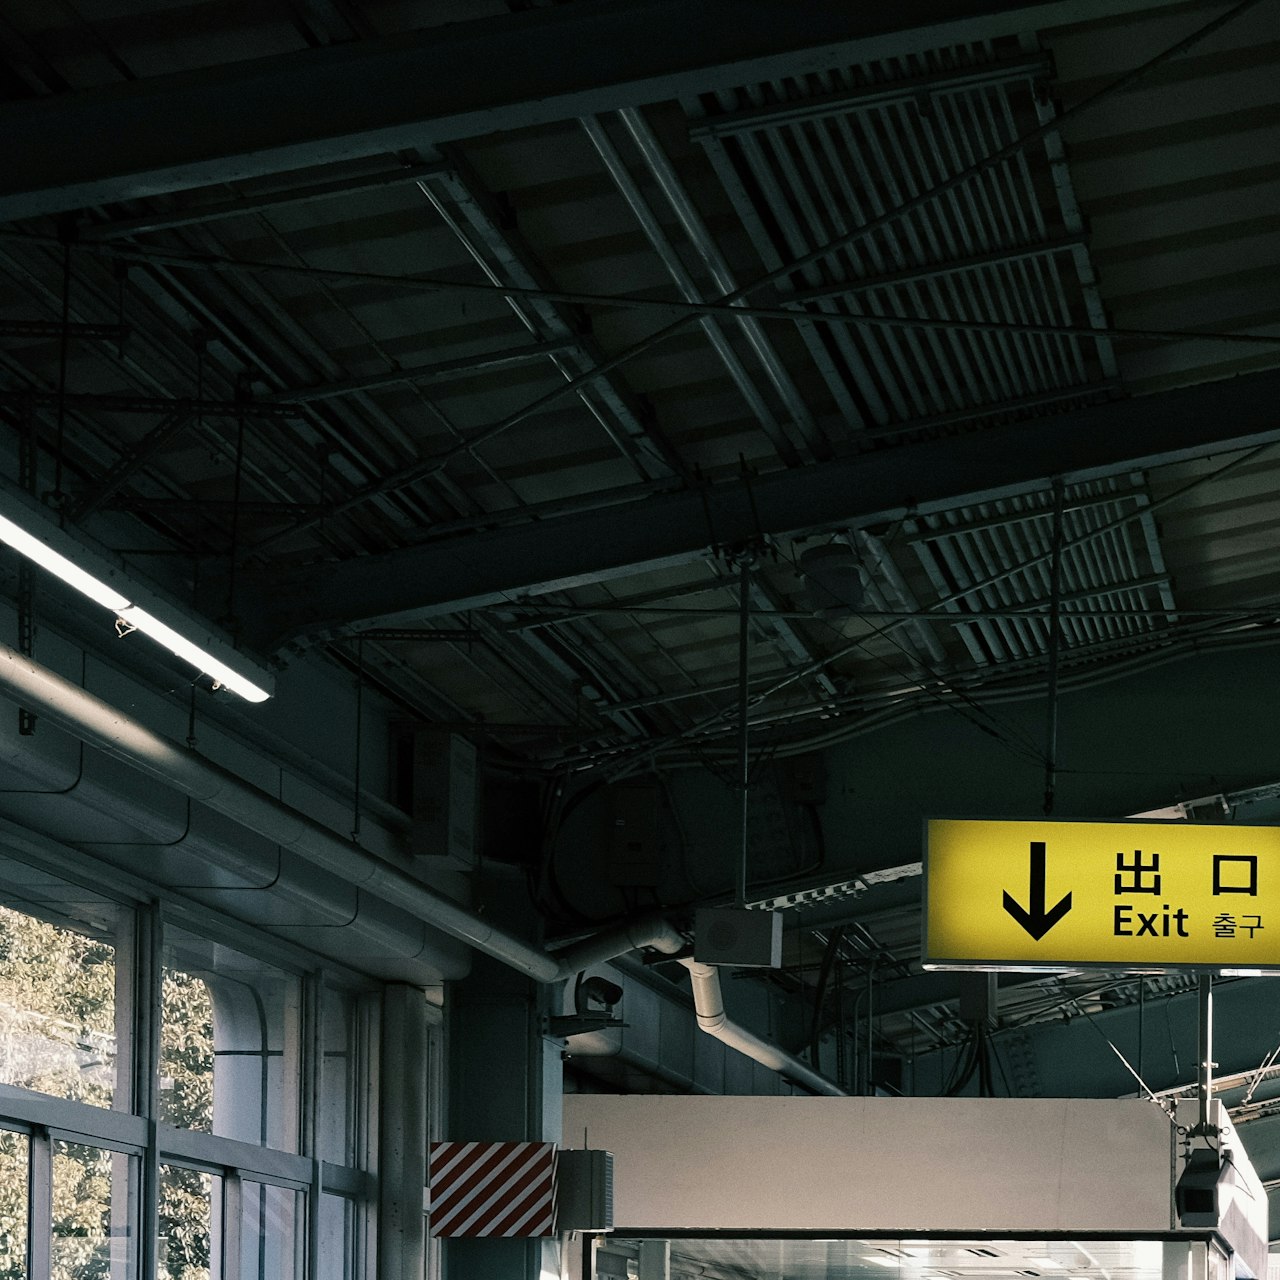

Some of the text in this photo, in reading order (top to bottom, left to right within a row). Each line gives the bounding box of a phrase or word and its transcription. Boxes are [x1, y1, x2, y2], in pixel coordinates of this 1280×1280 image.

[1114, 849, 1258, 897] 出口
[1113, 904, 1189, 938] Exit
[1211, 912, 1265, 939] 출구
